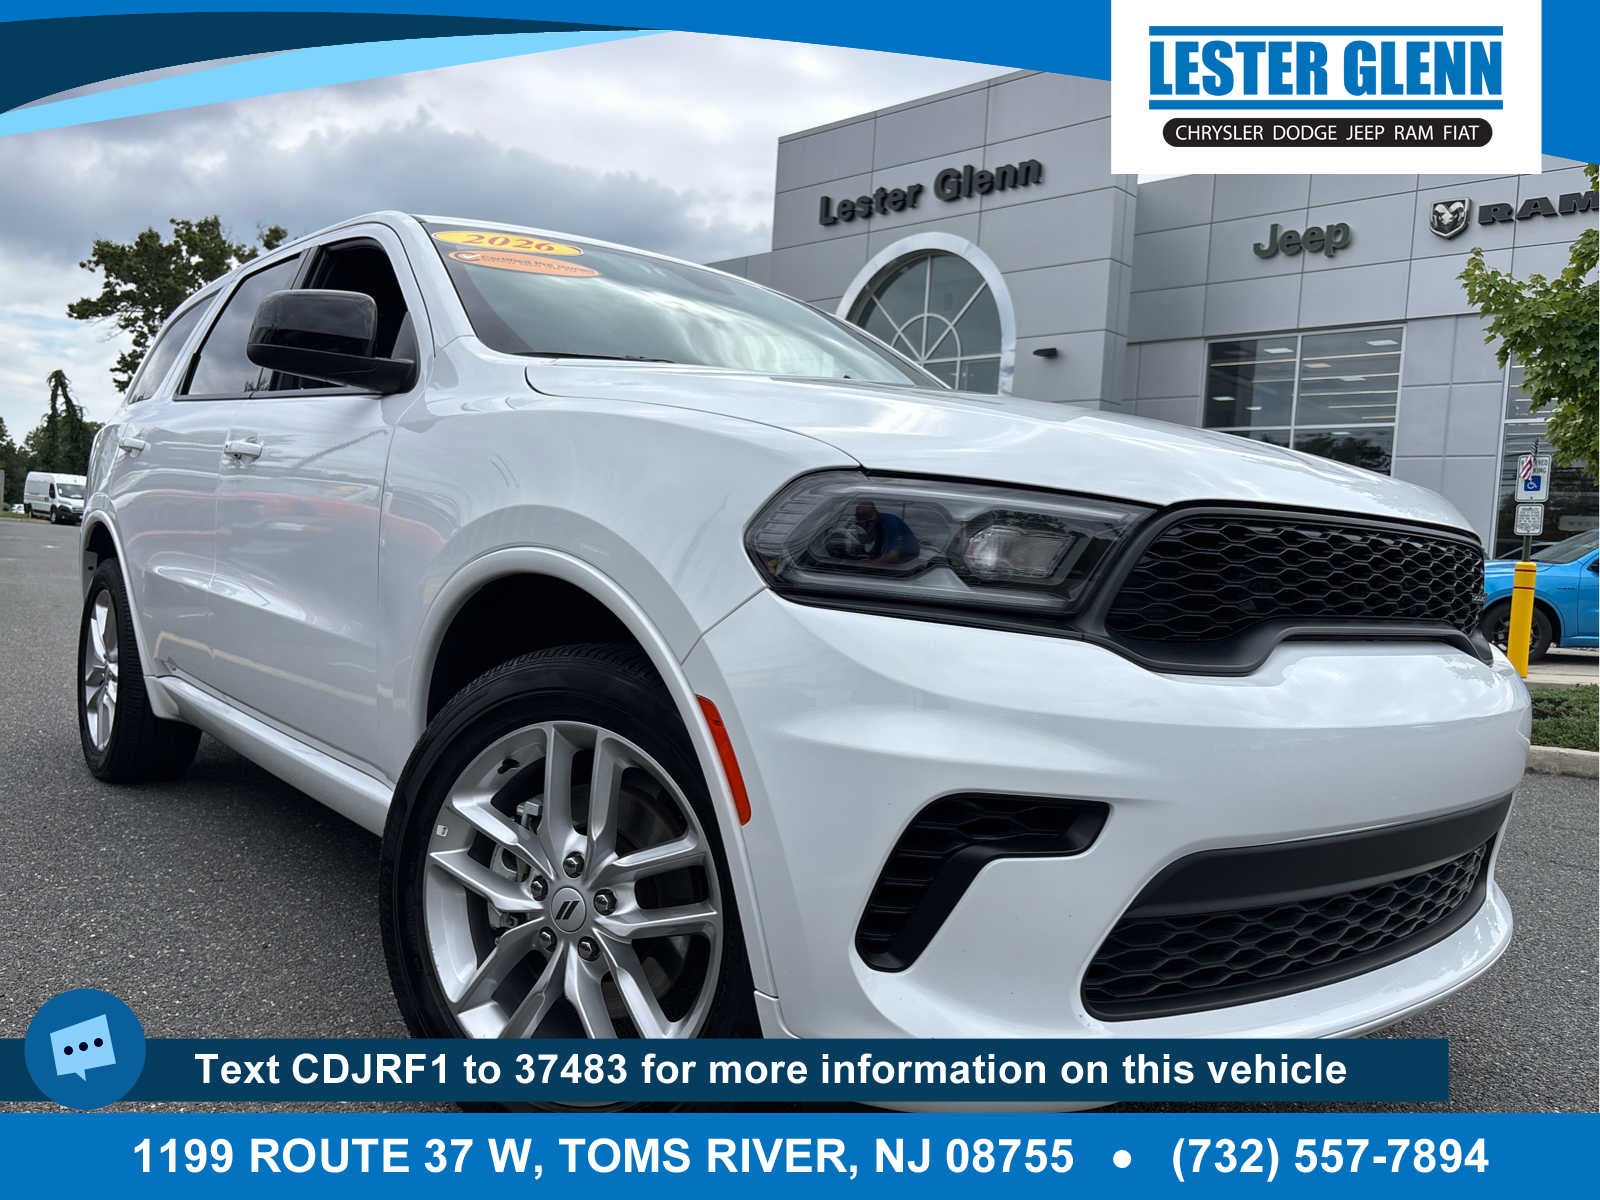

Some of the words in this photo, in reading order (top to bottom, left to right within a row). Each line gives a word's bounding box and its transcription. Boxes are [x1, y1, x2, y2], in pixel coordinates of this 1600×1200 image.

[819, 183, 924, 226] Lester
[934, 158, 1044, 203] Glenn
[1478, 191, 1599, 225] RAM
[462, 233, 556, 252] 2026
[1252, 221, 1353, 259] Jeep
